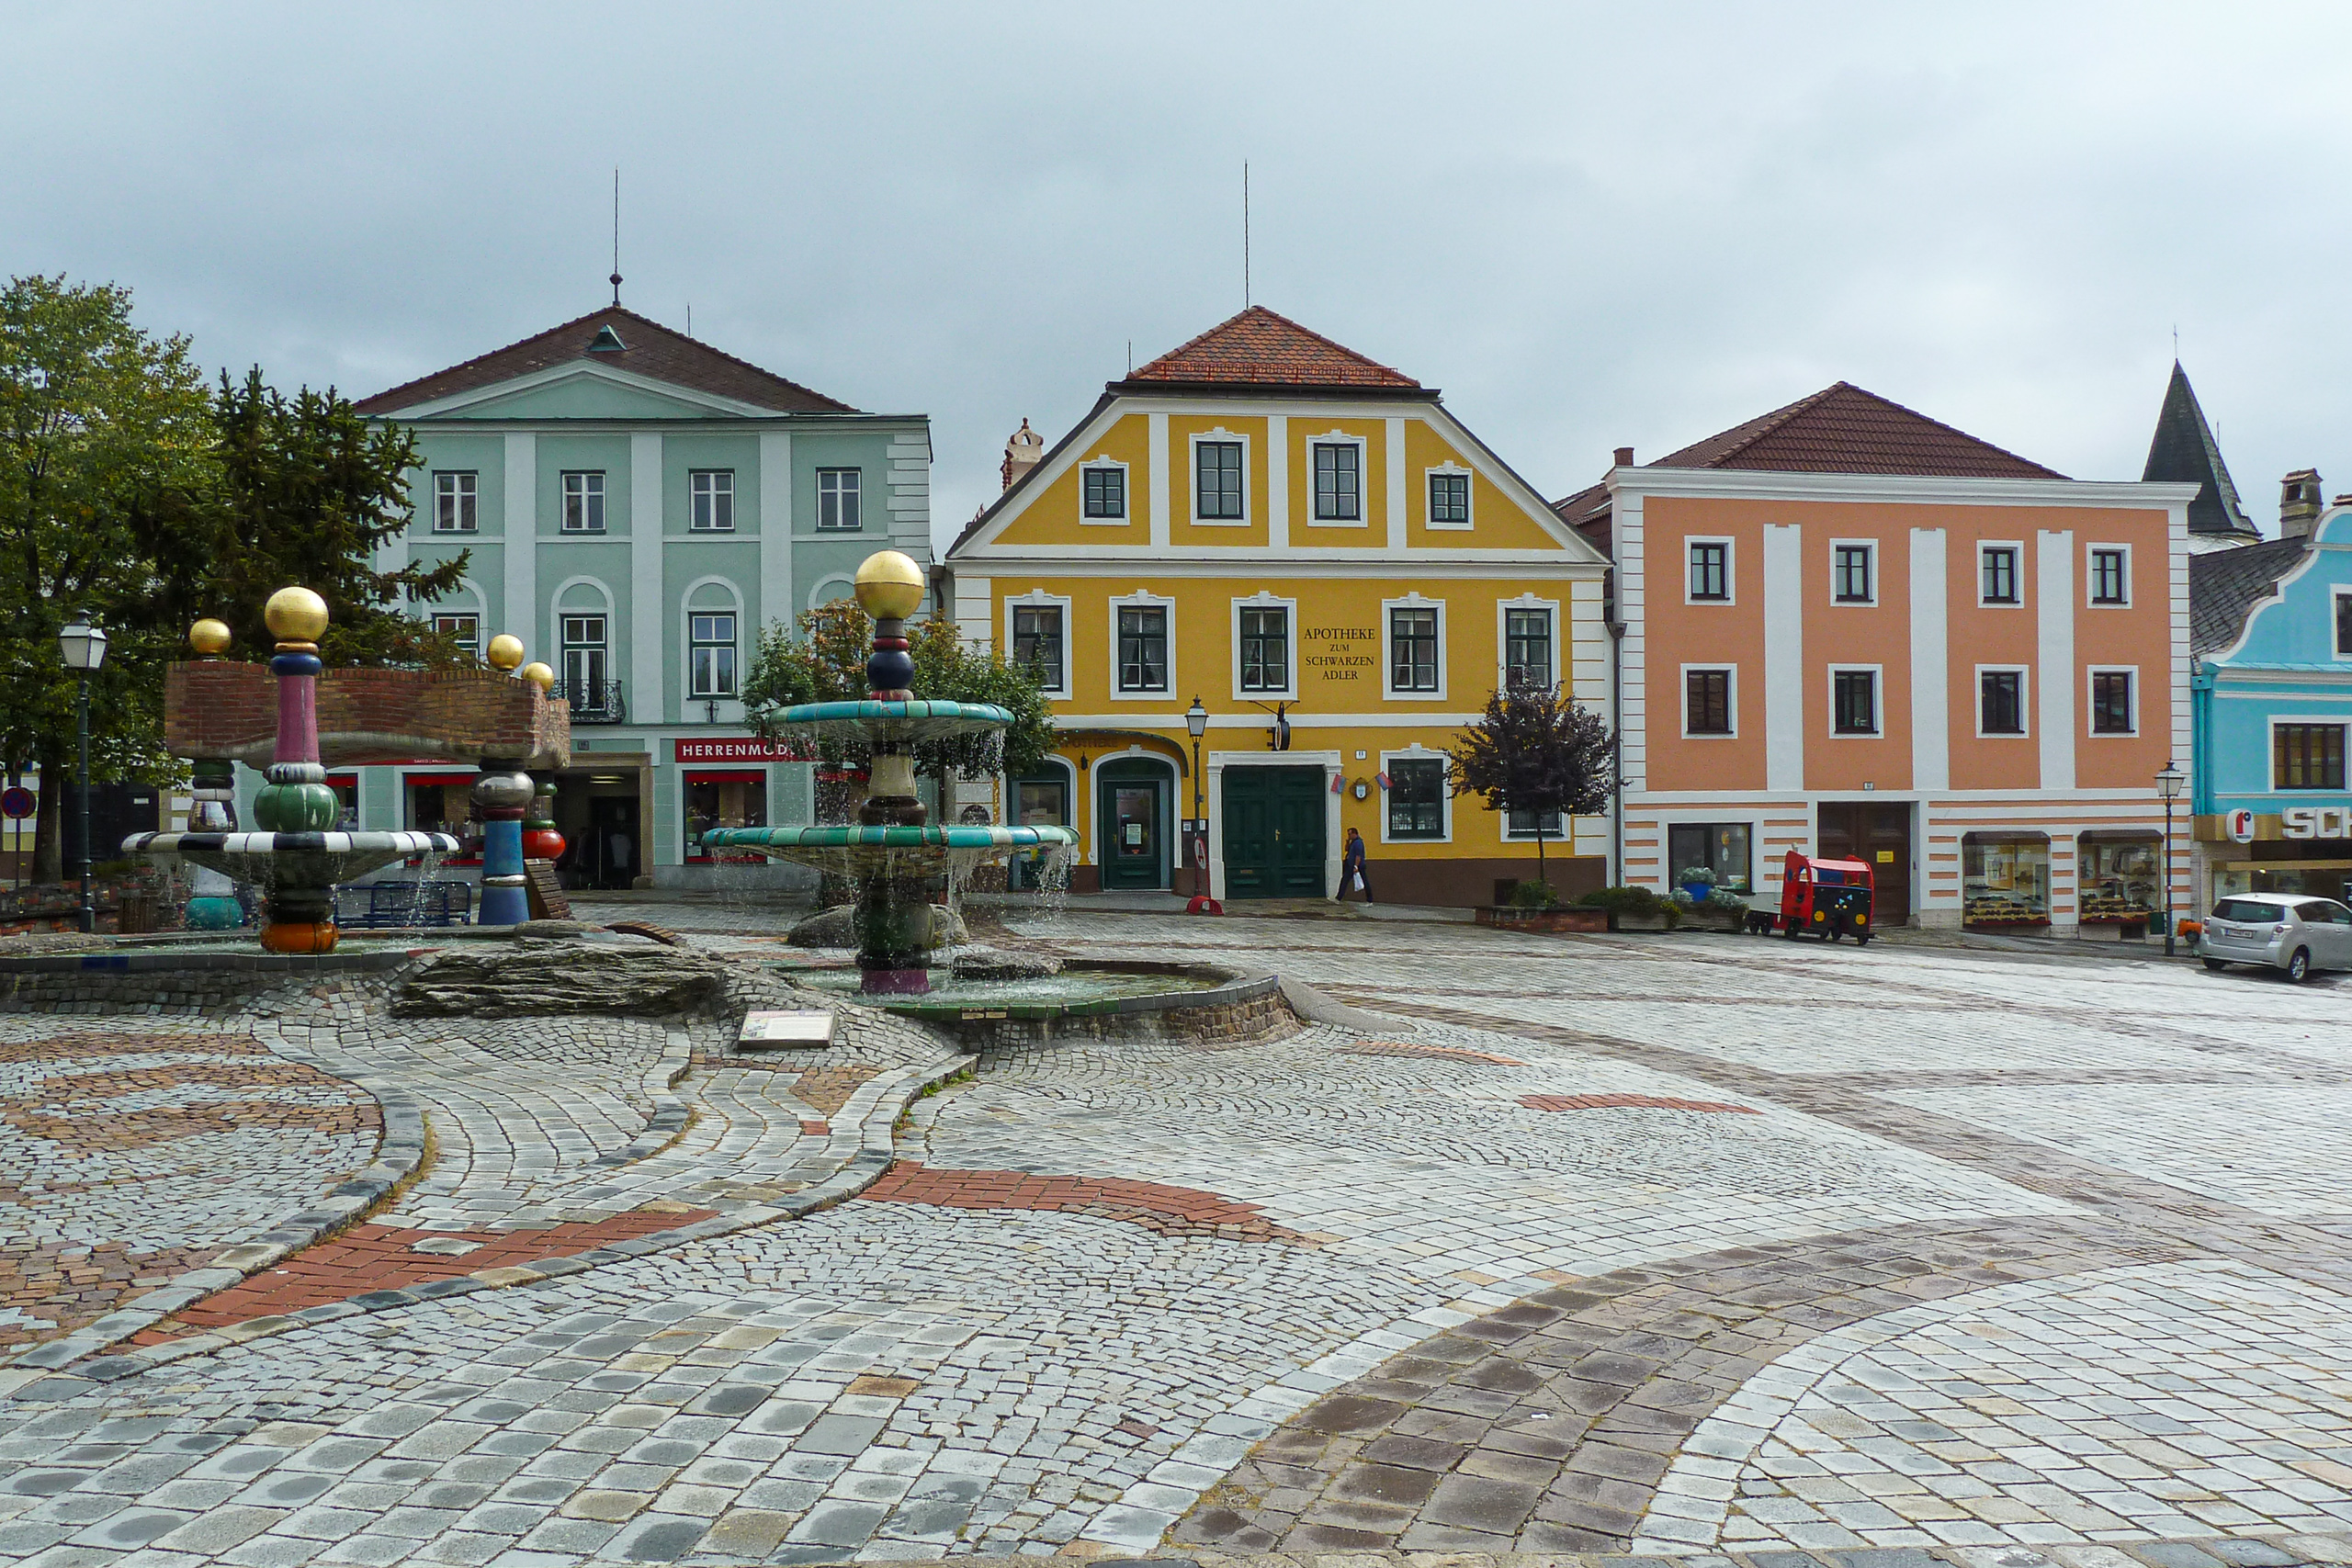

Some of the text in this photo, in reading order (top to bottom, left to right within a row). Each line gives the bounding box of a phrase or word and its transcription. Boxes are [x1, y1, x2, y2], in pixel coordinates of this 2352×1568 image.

[1304, 628, 1375, 639] APOTHEKE
[1306, 656, 1374, 666] SCHWARZEN
[1322, 670, 1358, 680] ADLER
[683, 745, 795, 756] HERRENMOD
